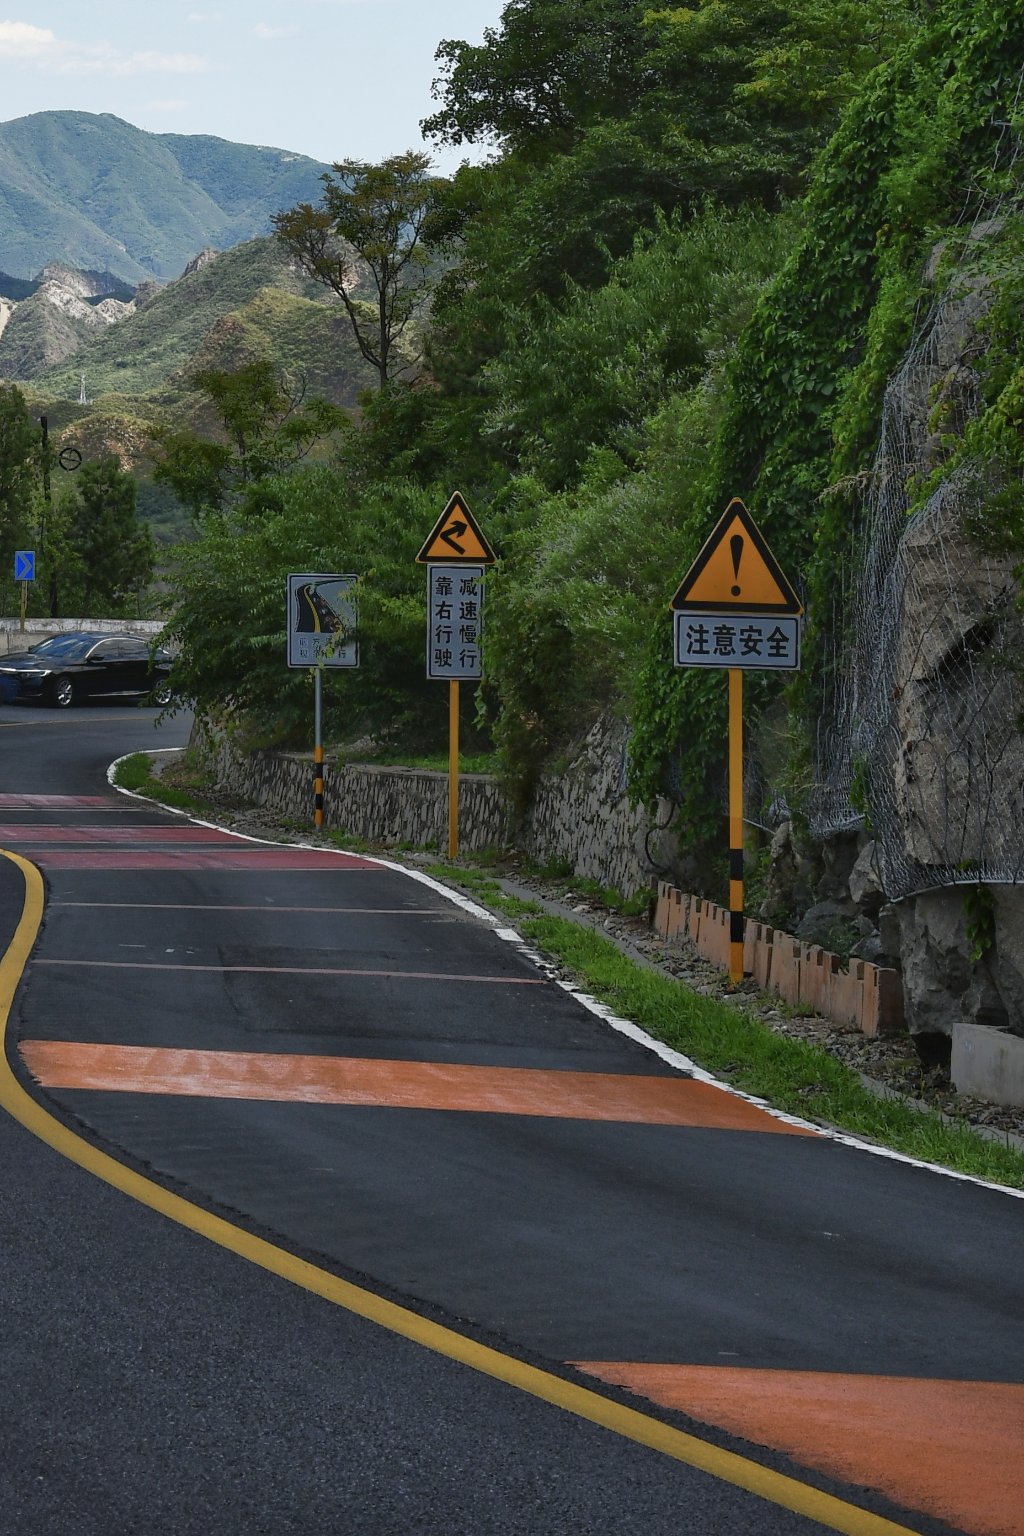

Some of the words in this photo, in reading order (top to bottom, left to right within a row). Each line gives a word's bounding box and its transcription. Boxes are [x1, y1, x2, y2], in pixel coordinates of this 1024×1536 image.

[435, 576, 453, 667] 靠右行驶
[459, 576, 477, 668] 减速慢行
[687, 624, 789, 658] 注意安全
